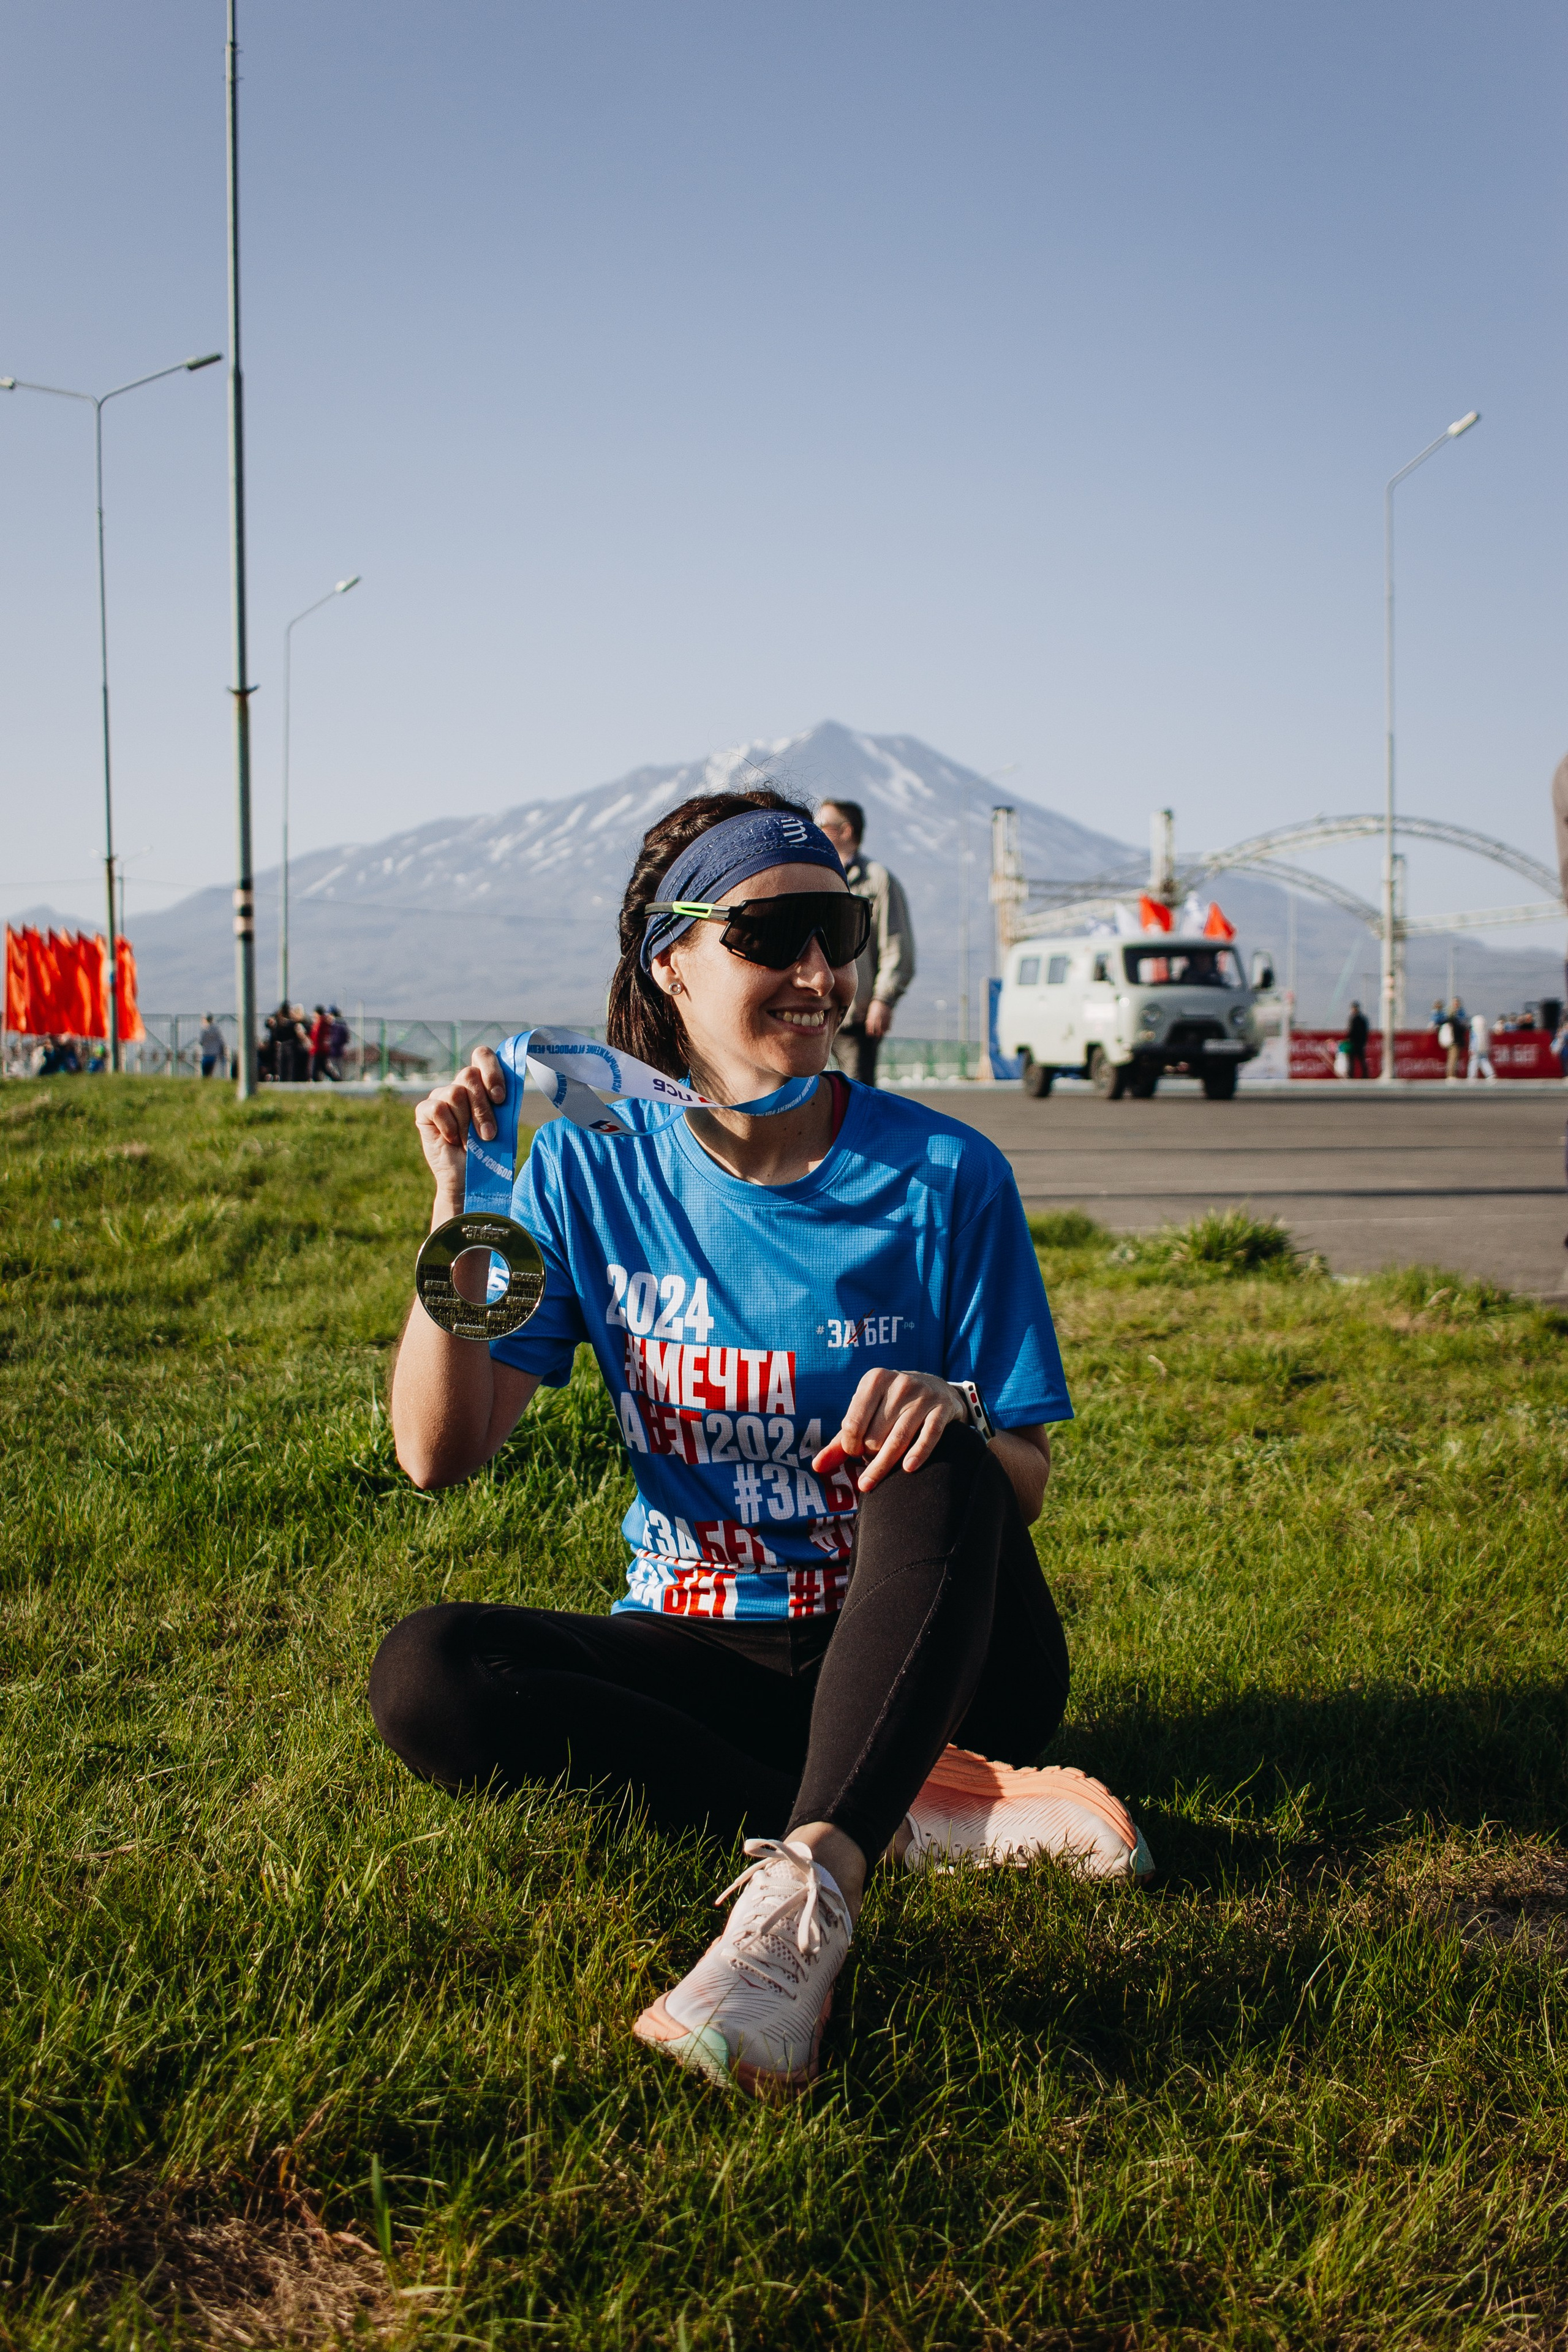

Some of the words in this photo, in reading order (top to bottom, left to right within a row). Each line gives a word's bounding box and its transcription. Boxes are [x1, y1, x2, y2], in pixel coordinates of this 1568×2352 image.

[653, 1079, 693, 1102] ПСБ
[481, 1155, 512, 1181] #СВОБОД
[606, 1263, 714, 1342] 2024
[625, 1333, 796, 1415] #МЕЧТА
